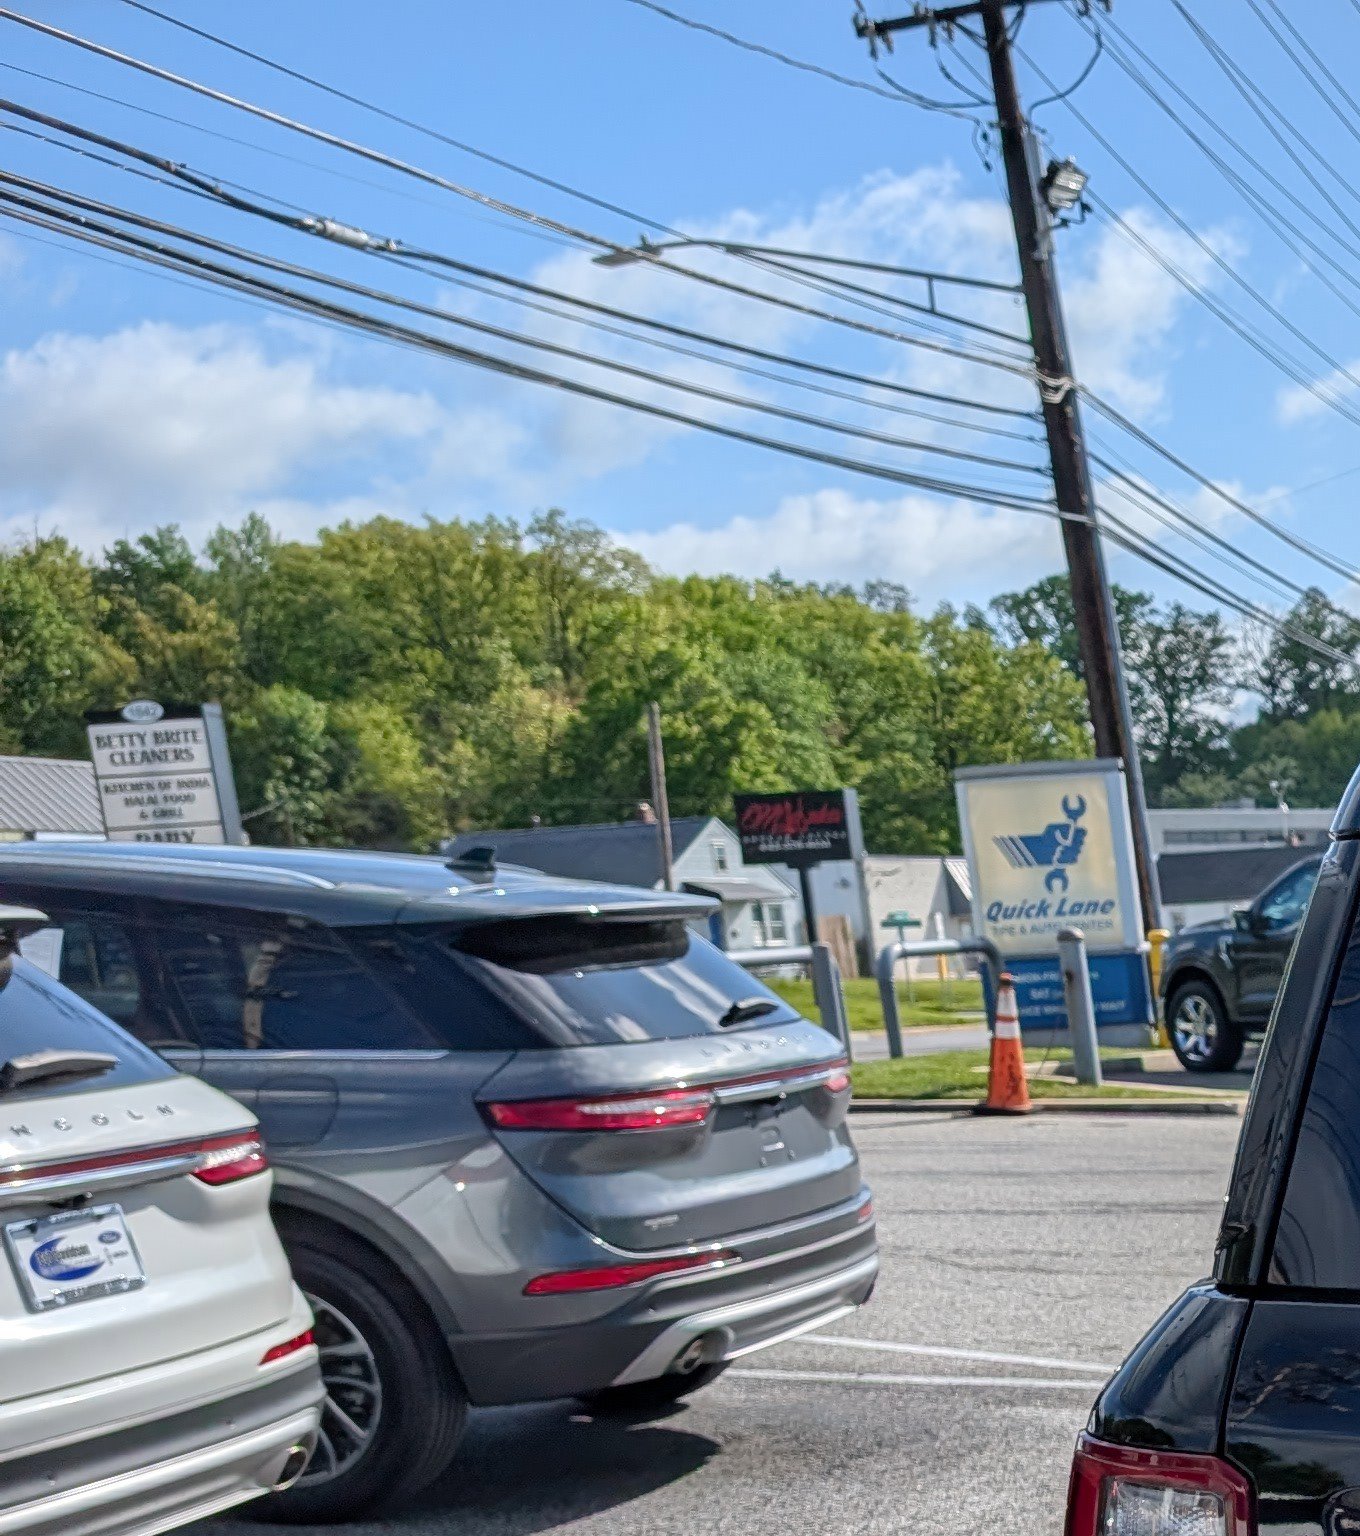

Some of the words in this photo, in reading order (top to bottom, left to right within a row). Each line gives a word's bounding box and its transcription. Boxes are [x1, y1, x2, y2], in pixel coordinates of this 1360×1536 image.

[95, 731, 147, 749] BETTY
[152, 728, 202, 745] BRITE
[109, 748, 195, 767] CLEANERS
[986, 899, 1050, 922] Quick
[1055, 897, 1116, 916] Lane
